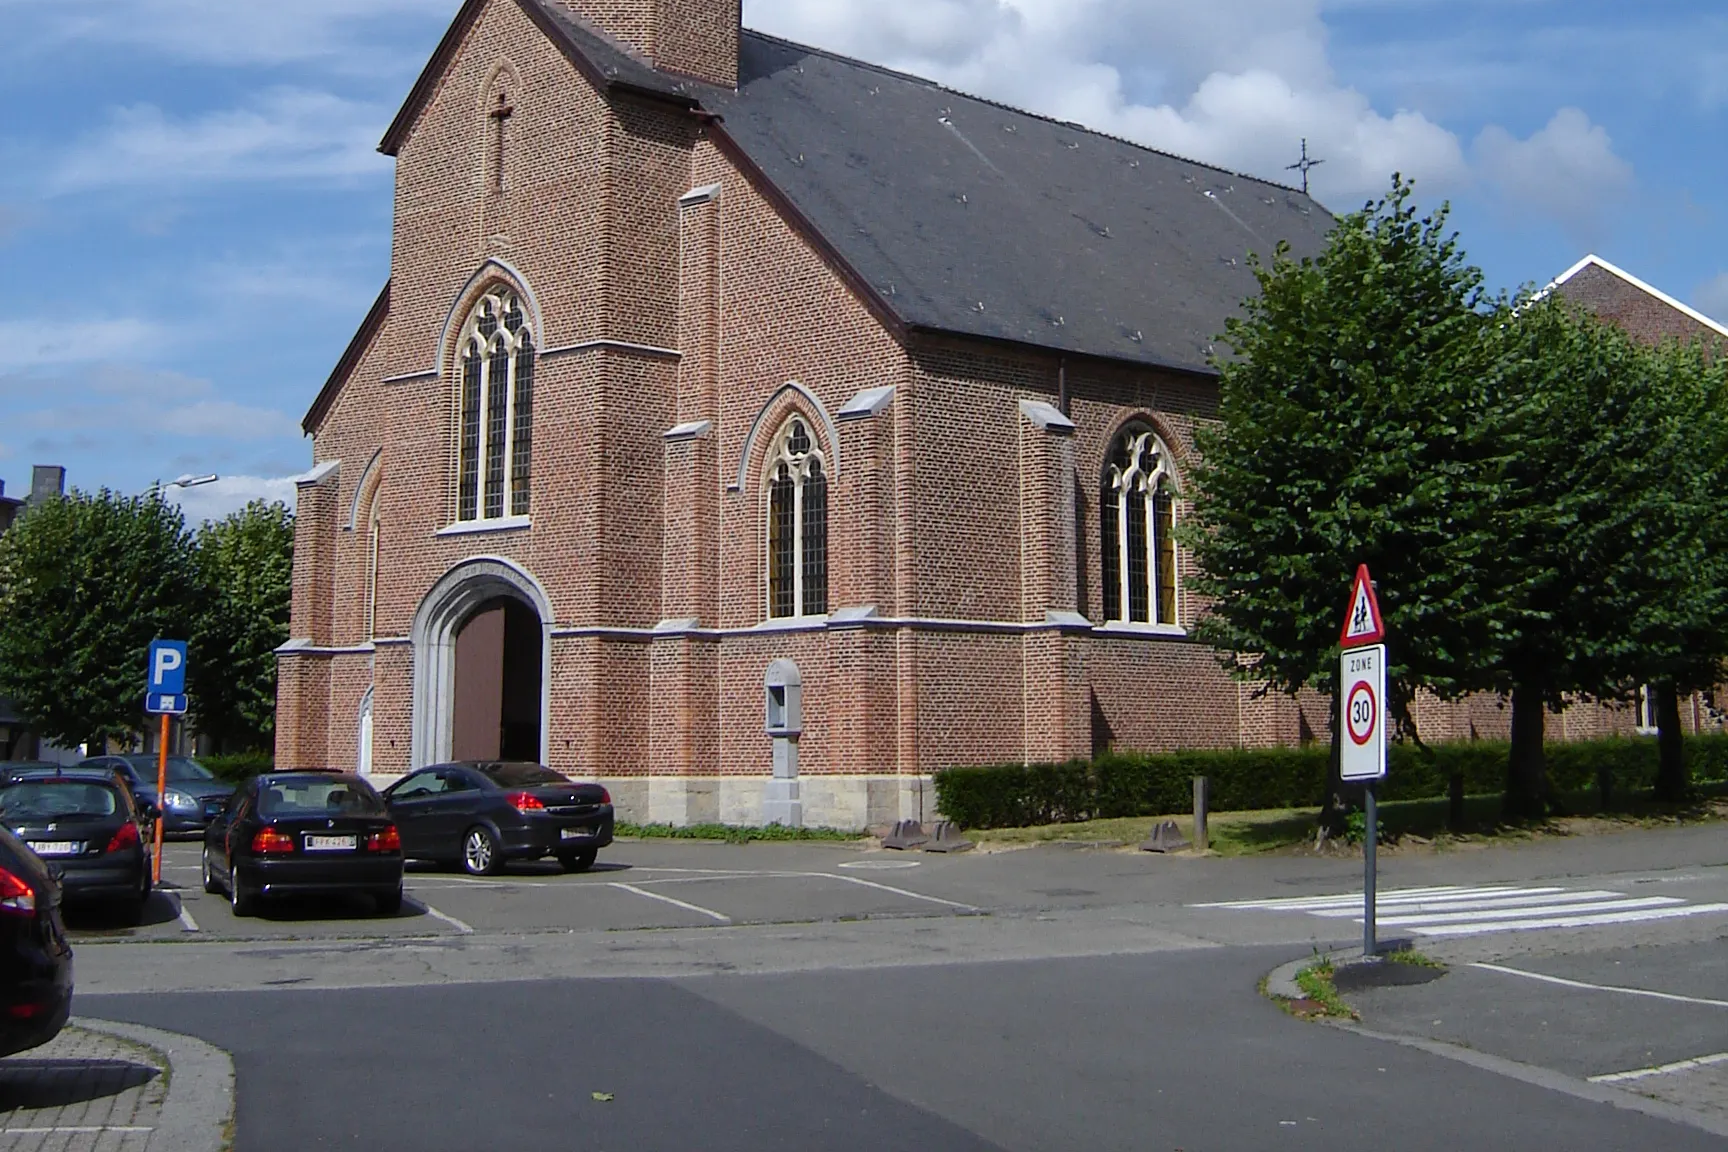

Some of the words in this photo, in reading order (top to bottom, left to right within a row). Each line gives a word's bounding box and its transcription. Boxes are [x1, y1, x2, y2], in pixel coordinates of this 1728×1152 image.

[154, 648, 181, 685] P
[1351, 657, 1372, 672] ZONE
[1353, 700, 1370, 724] 30
